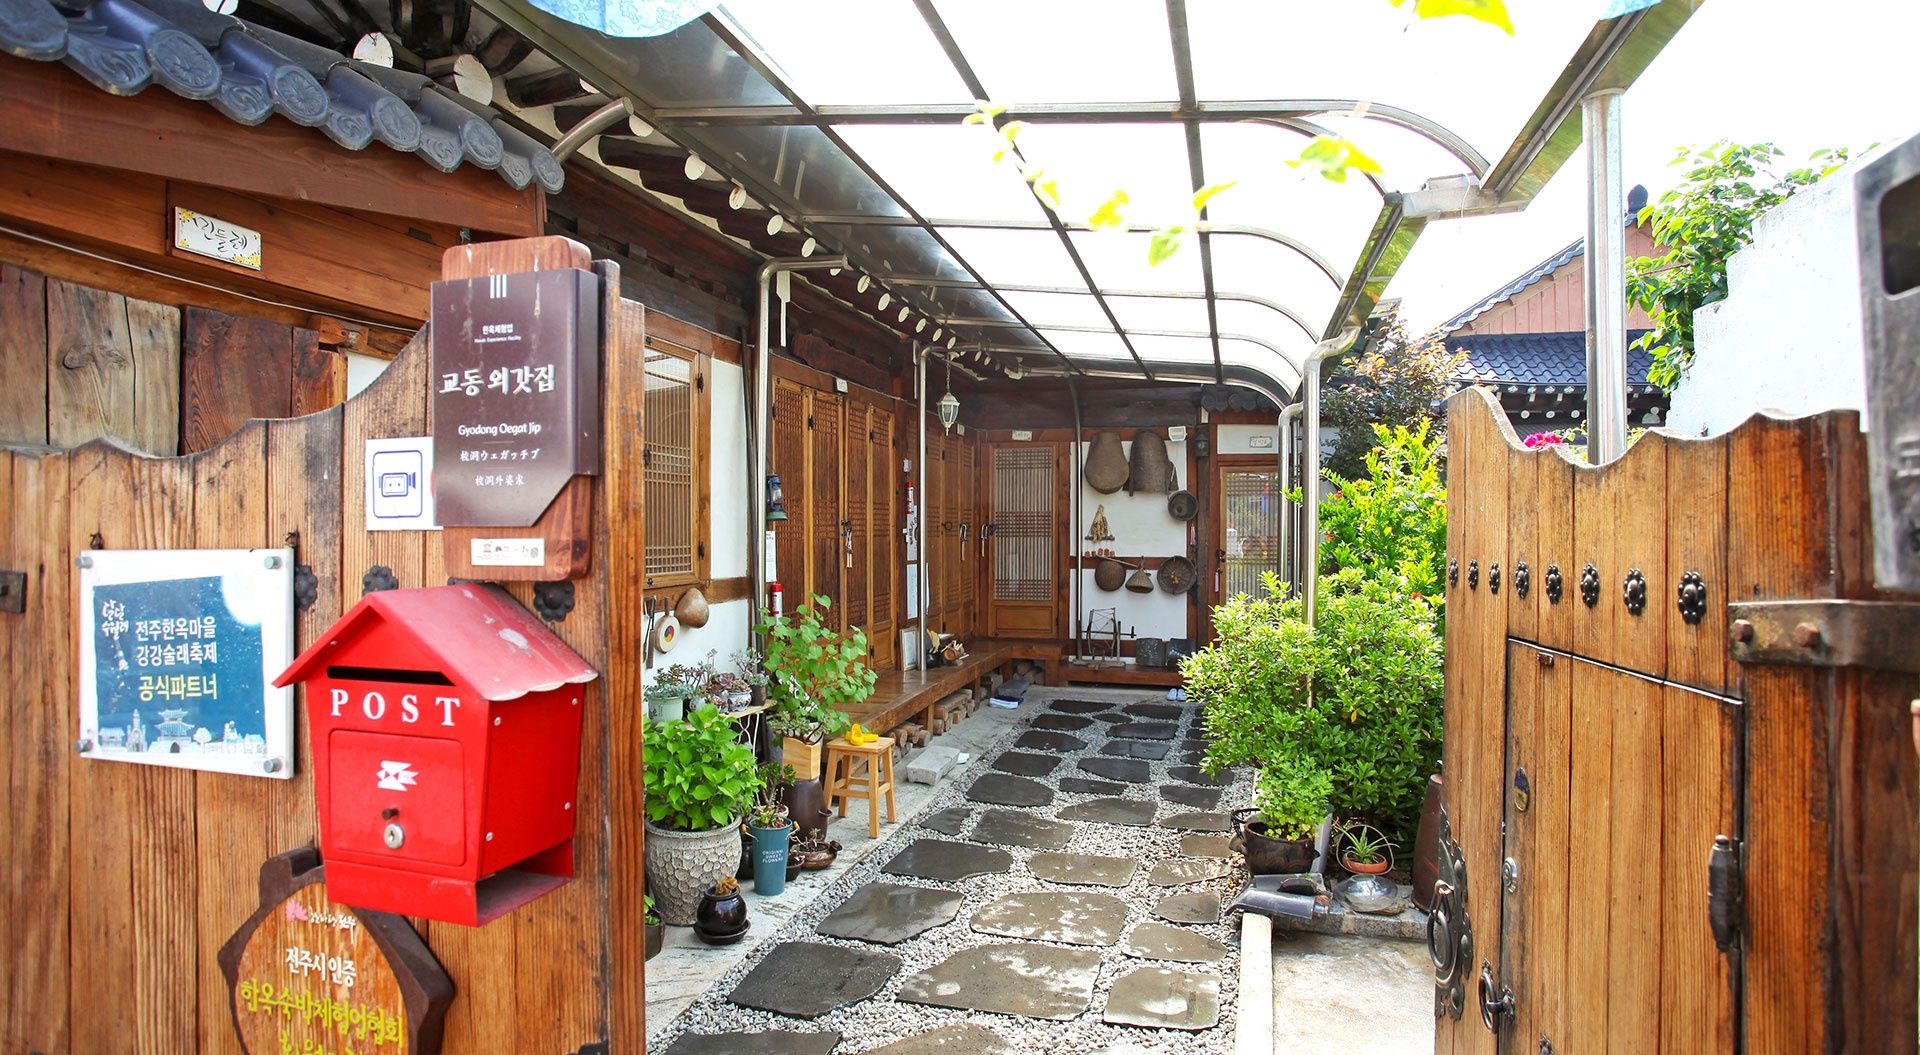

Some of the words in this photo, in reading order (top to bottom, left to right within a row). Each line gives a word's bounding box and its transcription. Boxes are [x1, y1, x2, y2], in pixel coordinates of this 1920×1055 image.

[439, 369, 485, 396] 교동
[487, 364, 556, 395] 외갓집
[458, 424, 498, 437] Gyodong
[499, 423, 528, 436] Oegat
[528, 421, 542, 435] Jip
[135, 616, 217, 642] 전주한옥마을
[136, 642, 218, 667] 강강술래축제
[139, 673, 218, 702] 공식파트너
[330, 688, 461, 727] POST
[286, 946, 326, 981] 전주시
[328, 956, 357, 988] 인증
